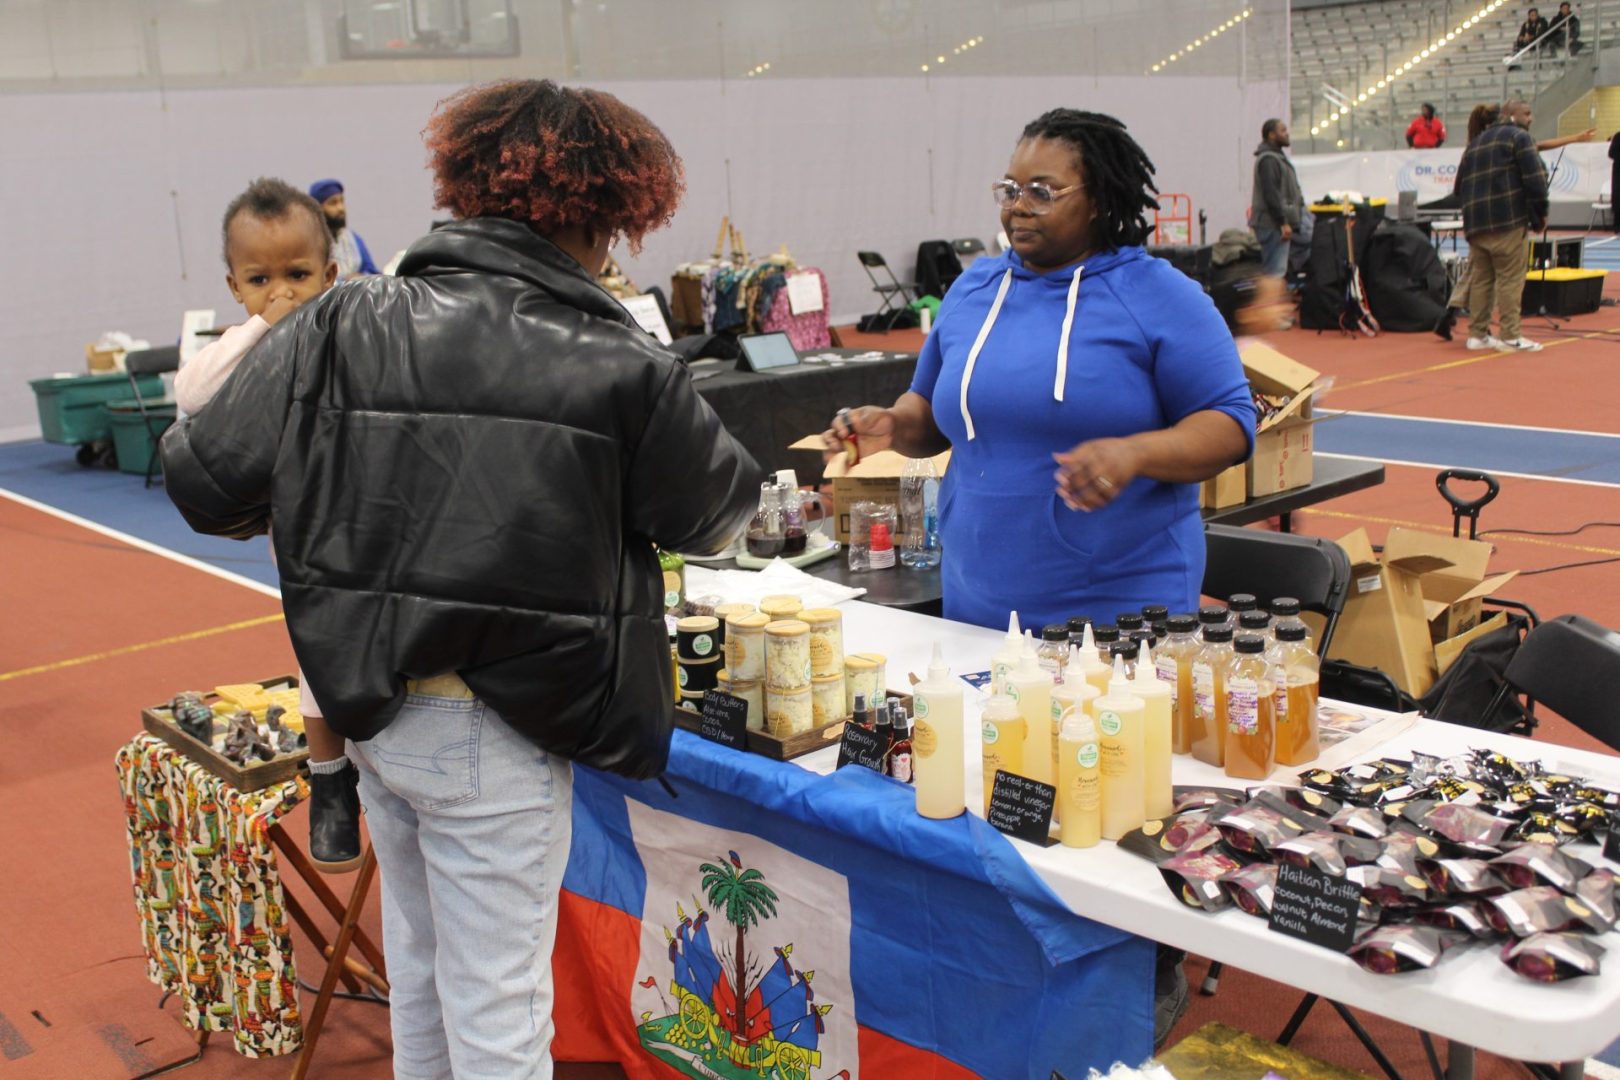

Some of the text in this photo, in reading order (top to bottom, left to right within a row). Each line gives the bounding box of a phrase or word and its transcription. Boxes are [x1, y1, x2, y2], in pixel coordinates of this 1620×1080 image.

[1415, 166, 1435, 175] DR.
[845, 723, 878, 753] Rosemary
[994, 782, 1051, 812] distilled vinegar
[1035, 783, 1052, 799] than
[1279, 864, 1361, 901] Haitian Brittle
